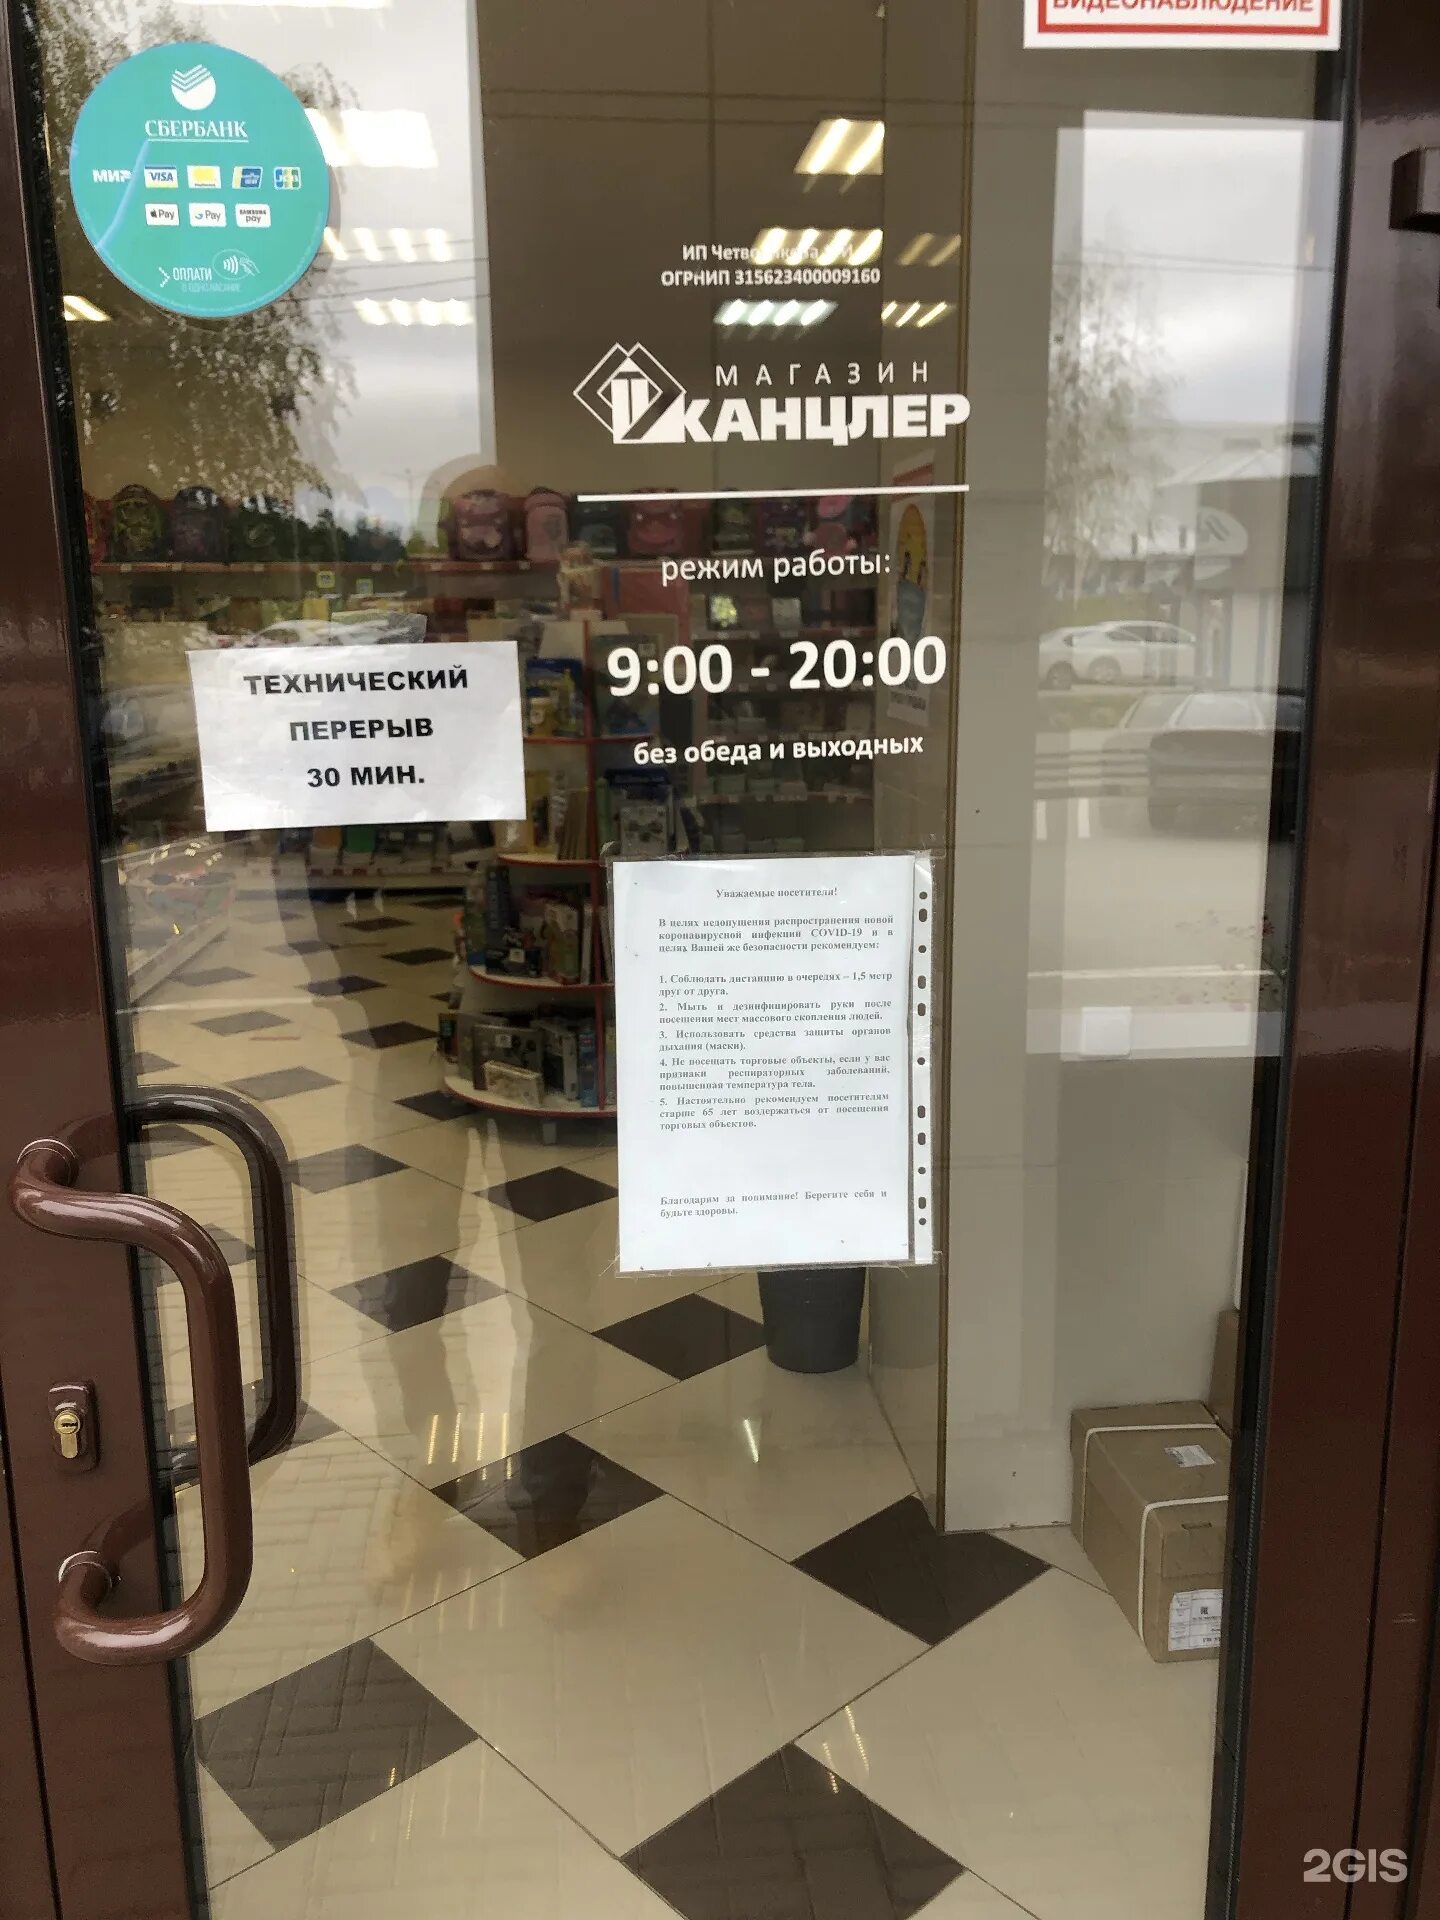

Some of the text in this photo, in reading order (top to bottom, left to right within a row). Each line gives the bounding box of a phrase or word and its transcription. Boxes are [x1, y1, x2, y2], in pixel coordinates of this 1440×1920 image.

[145, 120, 248, 138] СБЕРБАНК
[93, 169, 132, 183] МИР
[148, 172, 174, 182] VISA
[159, 209, 175, 219] Pay
[205, 210, 221, 221] Pay
[246, 215, 261, 223] pay
[683, 245, 707, 260] ИП
[173, 267, 212, 280] ОПЛАТИ
[661, 268, 880, 286] ОГРНИП 315623400009160
[716, 361, 928, 385] МАГАЗИН
[684, 393, 971, 446] КАНЦЛЕР
[662, 548, 890, 586] режим работы:
[607, 636, 947, 697] 9:00 - 20:00
[244, 664, 468, 695] ТЕХНИЧЕСКИЙ
[290, 718, 434, 741] ПЕРЕРЫВ
[634, 735, 924, 765] без обеда и выходных
[307, 765, 425, 787] 30 МИН.
[716, 889, 775, 898] Уважаемые
[659, 919, 666, 927] В
[703, 918, 770, 928] недопущения
[774, 917, 859, 927] распространения
[864, 916, 893, 924] новой
[659, 931, 741, 941] коронавирусной
[752, 930, 801, 940] инфекции
[811, 928, 862, 938] COVID-19
[659, 945, 687, 953] целях
[691, 943, 724, 952] Вашей
[743, 942, 807, 951] безопасности
[811, 942, 879, 951] рекомендуем:
[671, 975, 726, 983] Соблюдать
[729, 975, 784, 984] дистанцию
[796, 974, 840, 983] очередях
[853, 972, 866, 981] 1,5
[869, 973, 892, 982] метр
[659, 989, 681, 998] друг
[697, 988, 728, 997] друга.
[659, 1003, 667, 1011] 2.
[677, 1002, 707, 1011] Мыть
[733, 1002, 821, 1012] дезинфицировать
[831, 1001, 854, 1010] руки
[865, 1000, 891, 1008] после
[660, 1016, 713, 1024] посещения
[795, 1014, 846, 1022] скопления
[849, 1012, 882, 1021] людей.
[659, 1028, 891, 1039] 3. Использовать средства защиты органов
[659, 1041, 745, 1052] дыхания (маски).
[672, 1058, 685, 1066] Не
[689, 1058, 736, 1066] посещать
[740, 1057, 786, 1066] торговые
[791, 1056, 836, 1065] объекты,
[865, 1056, 870, 1064] у
[660, 1065, 890, 1080] признаки респираторных заболеваний,
[660, 1080, 815, 1090] повышенная температура тела.
[660, 1093, 889, 1106] 5. Настоятельно рекомендуем посетителям
[660, 1111, 695, 1119] старше
[703, 1108, 713, 1116] 65
[744, 1107, 810, 1117] воздержаться
[837, 1105, 889, 1113] посещения
[660, 1119, 756, 1131] торговых объектов.
[660, 1196, 719, 1206] Благодарим
[742, 1192, 799, 1202] понимание!
[805, 1191, 848, 1201] Берегите
[854, 1190, 874, 1198] себя
[660, 1207, 738, 1219] будьте здоровы.
